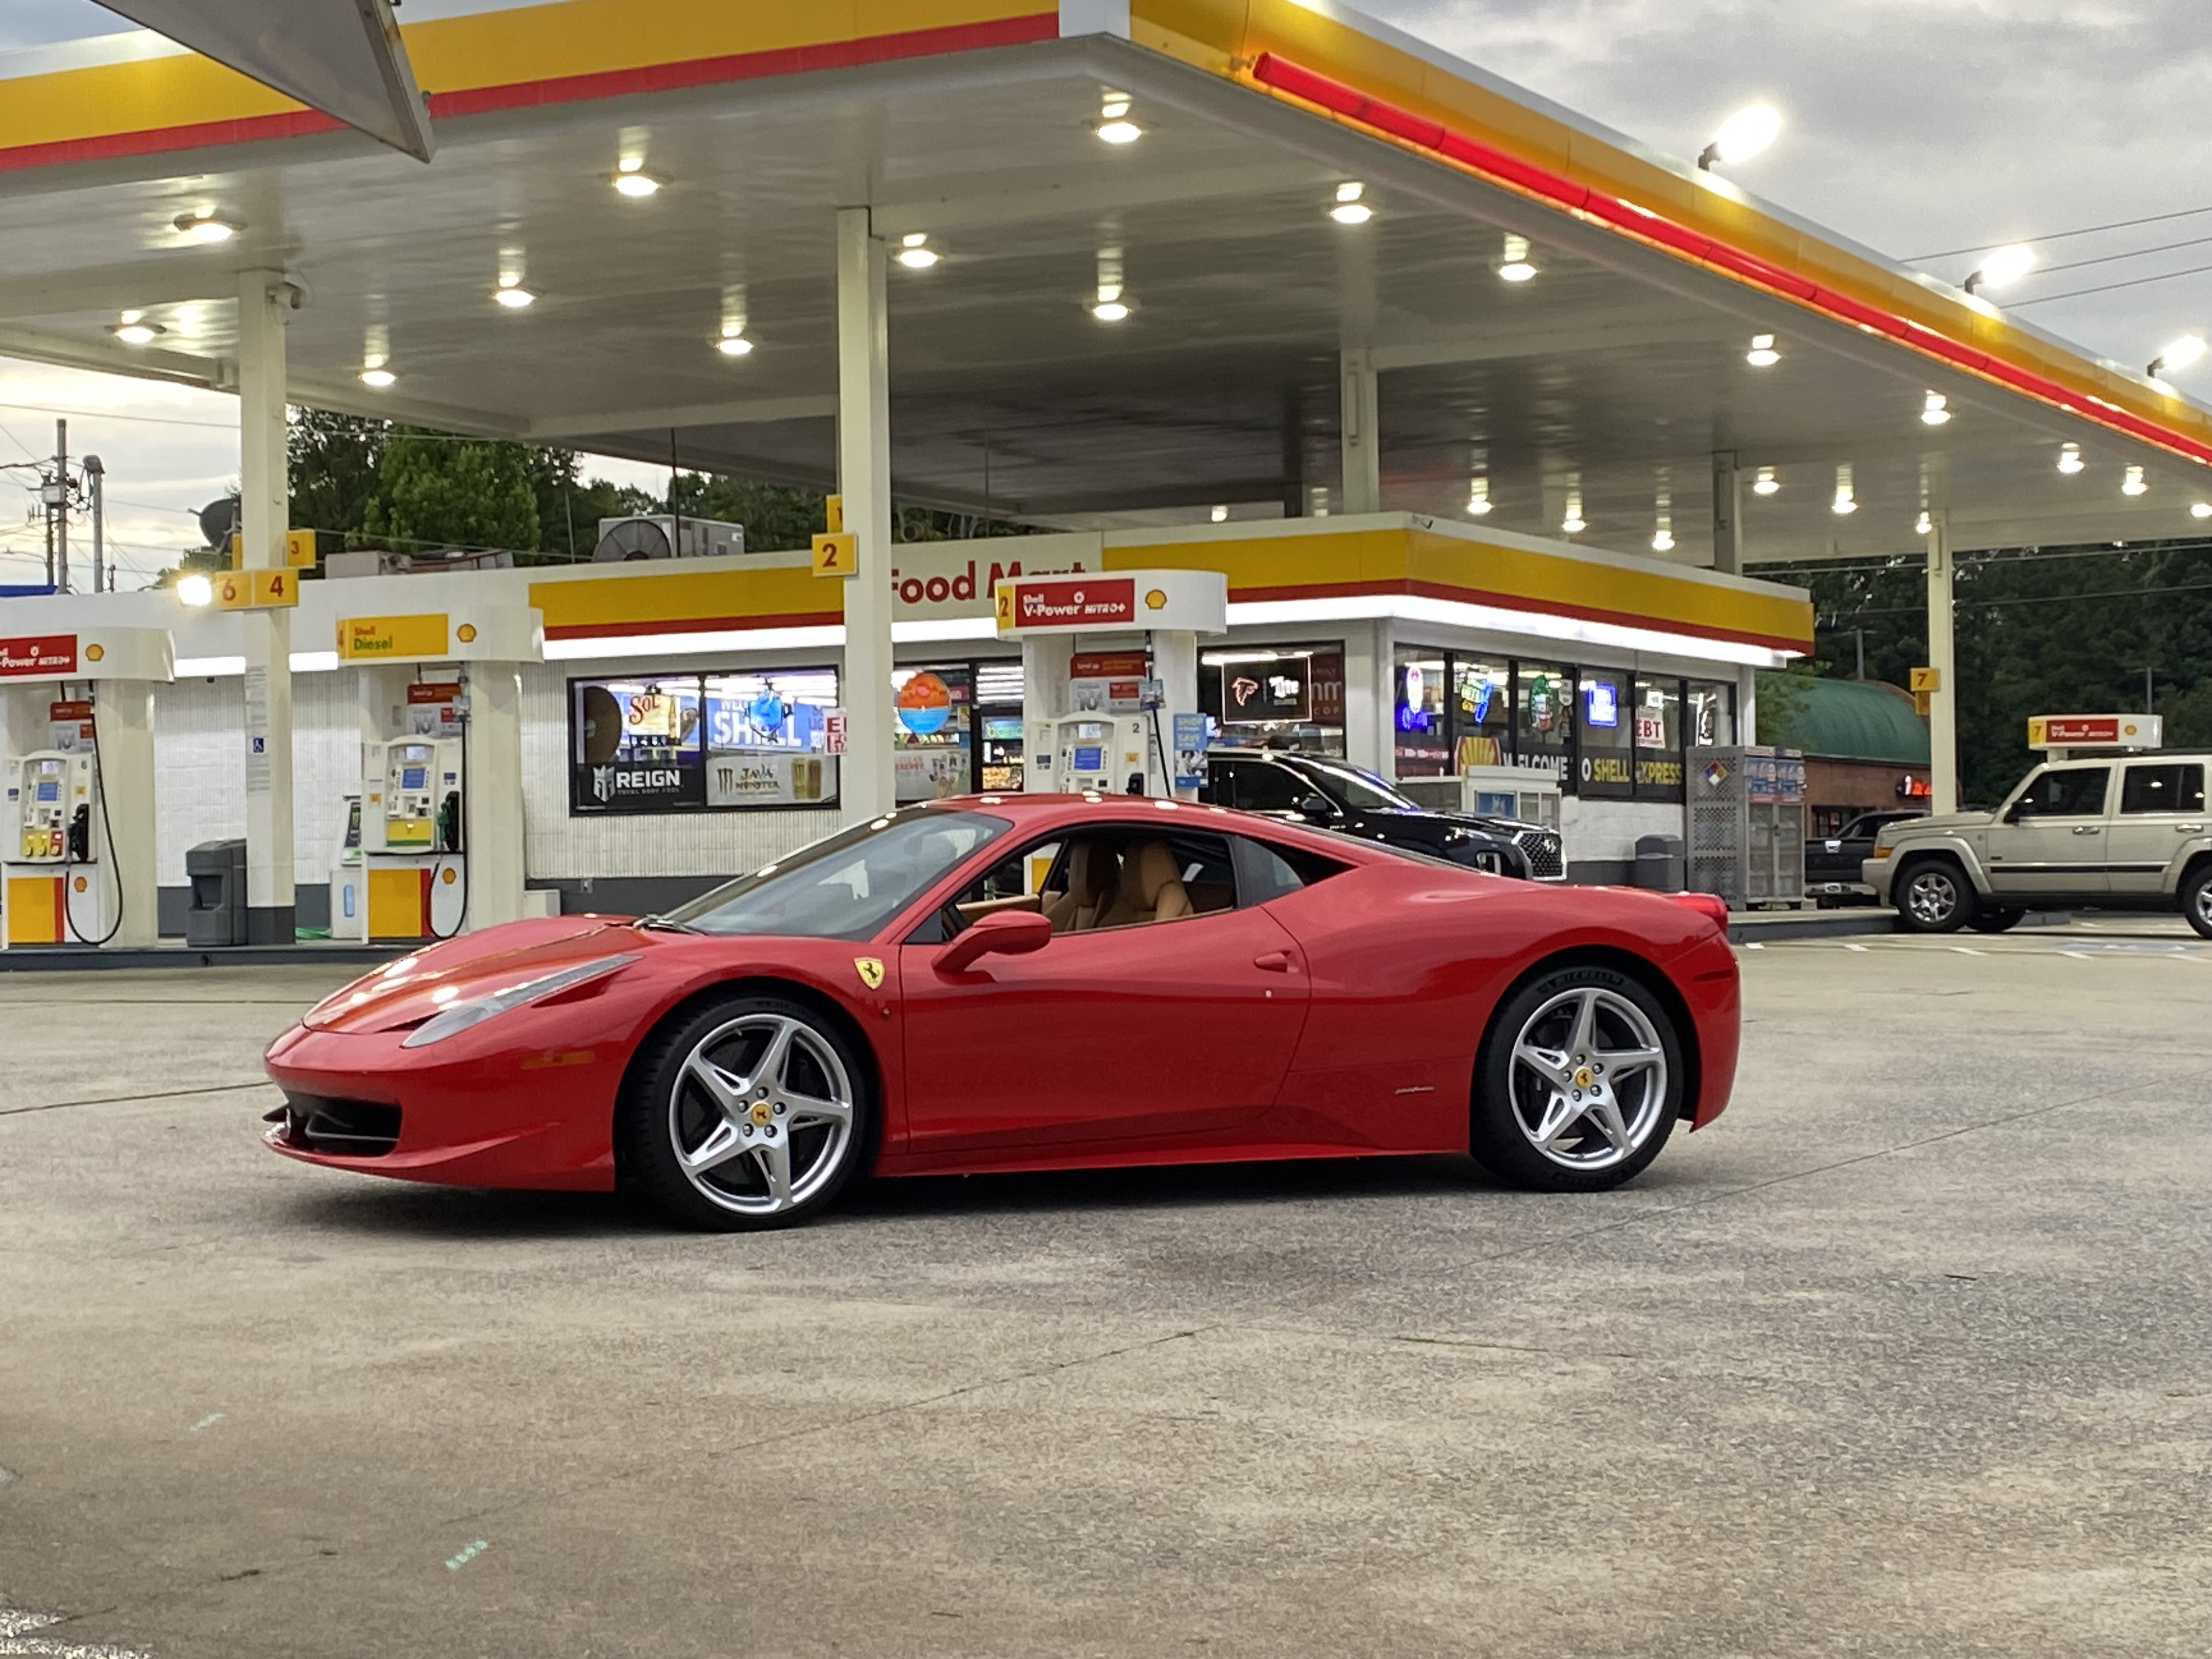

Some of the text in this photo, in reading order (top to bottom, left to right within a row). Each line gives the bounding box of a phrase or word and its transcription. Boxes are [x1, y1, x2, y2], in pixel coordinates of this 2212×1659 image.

[291, 540, 300, 555] 3
[822, 542, 837, 568] 2
[222, 578, 236, 601] 6
[269, 575, 284, 597] 4
[891, 560, 975, 604] ood
[1000, 595, 1009, 618] 2
[1023, 602, 1080, 617] V-Power
[354, 635, 393, 651] Diesel
[1917, 673, 1927, 687] 7
[1132, 723, 1140, 733] 2
[1636, 719, 1662, 738] EBT
[2034, 725, 2041, 737] 7
[616, 769, 681, 788] REIGN
[741, 764, 774, 780] JAVA
[1593, 758, 1630, 783] SHELL
[735, 780, 780, 791] MONSTER
